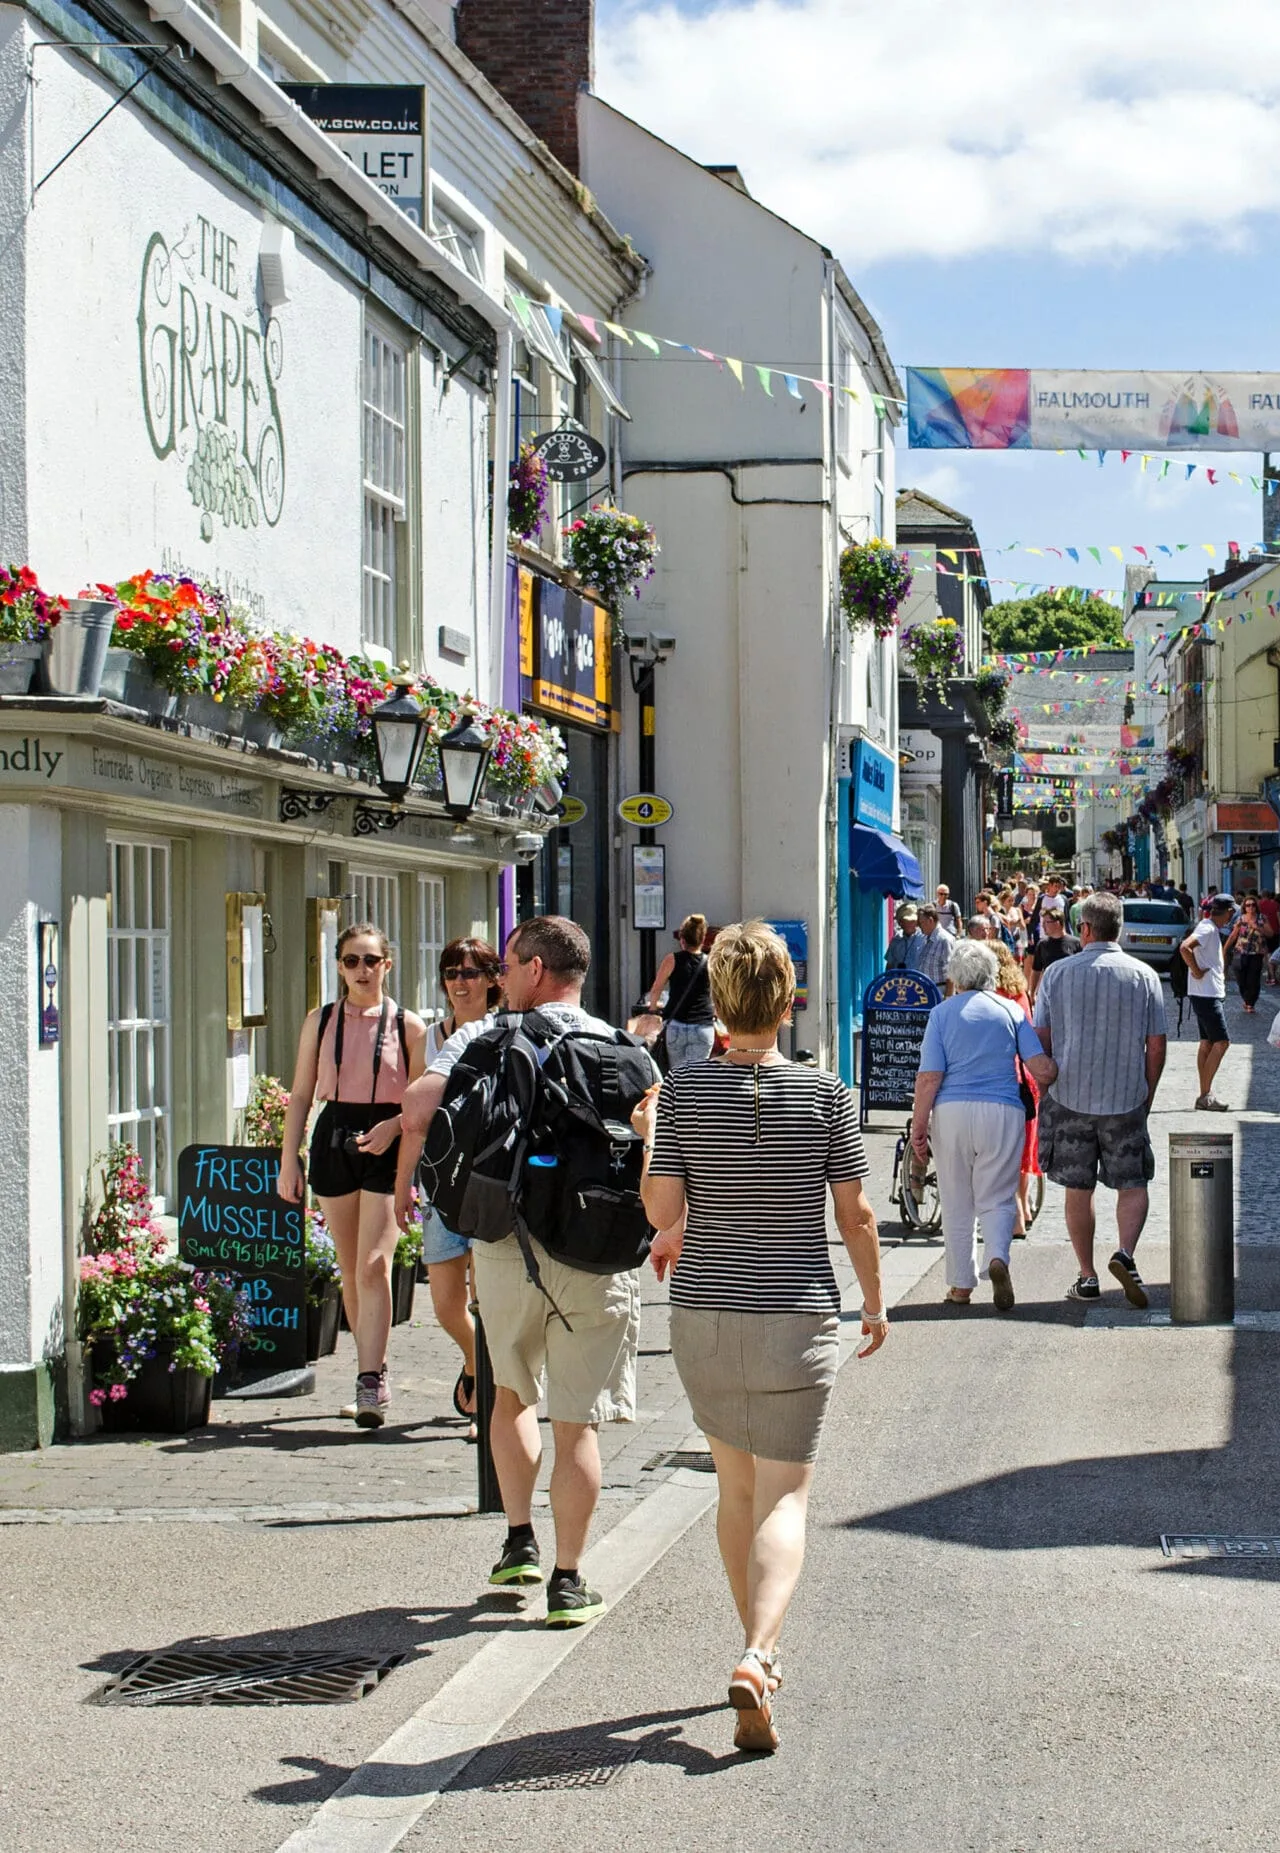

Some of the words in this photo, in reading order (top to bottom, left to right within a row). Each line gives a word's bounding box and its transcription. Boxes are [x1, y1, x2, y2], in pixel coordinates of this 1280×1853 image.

[363, 152, 414, 179] LET
[197, 213, 238, 300] THE
[136, 231, 285, 528] GRAPES
[1037, 391, 1149, 409] FALMOUTH
[92, 747, 134, 783] Fairtrade
[138, 757, 174, 791] Organic
[178, 766, 216, 800] Espresso
[640, 804, 649, 817] 4
[196, 1149, 279, 1194] FRESH
[180, 1195, 300, 1244] MUSSELS
